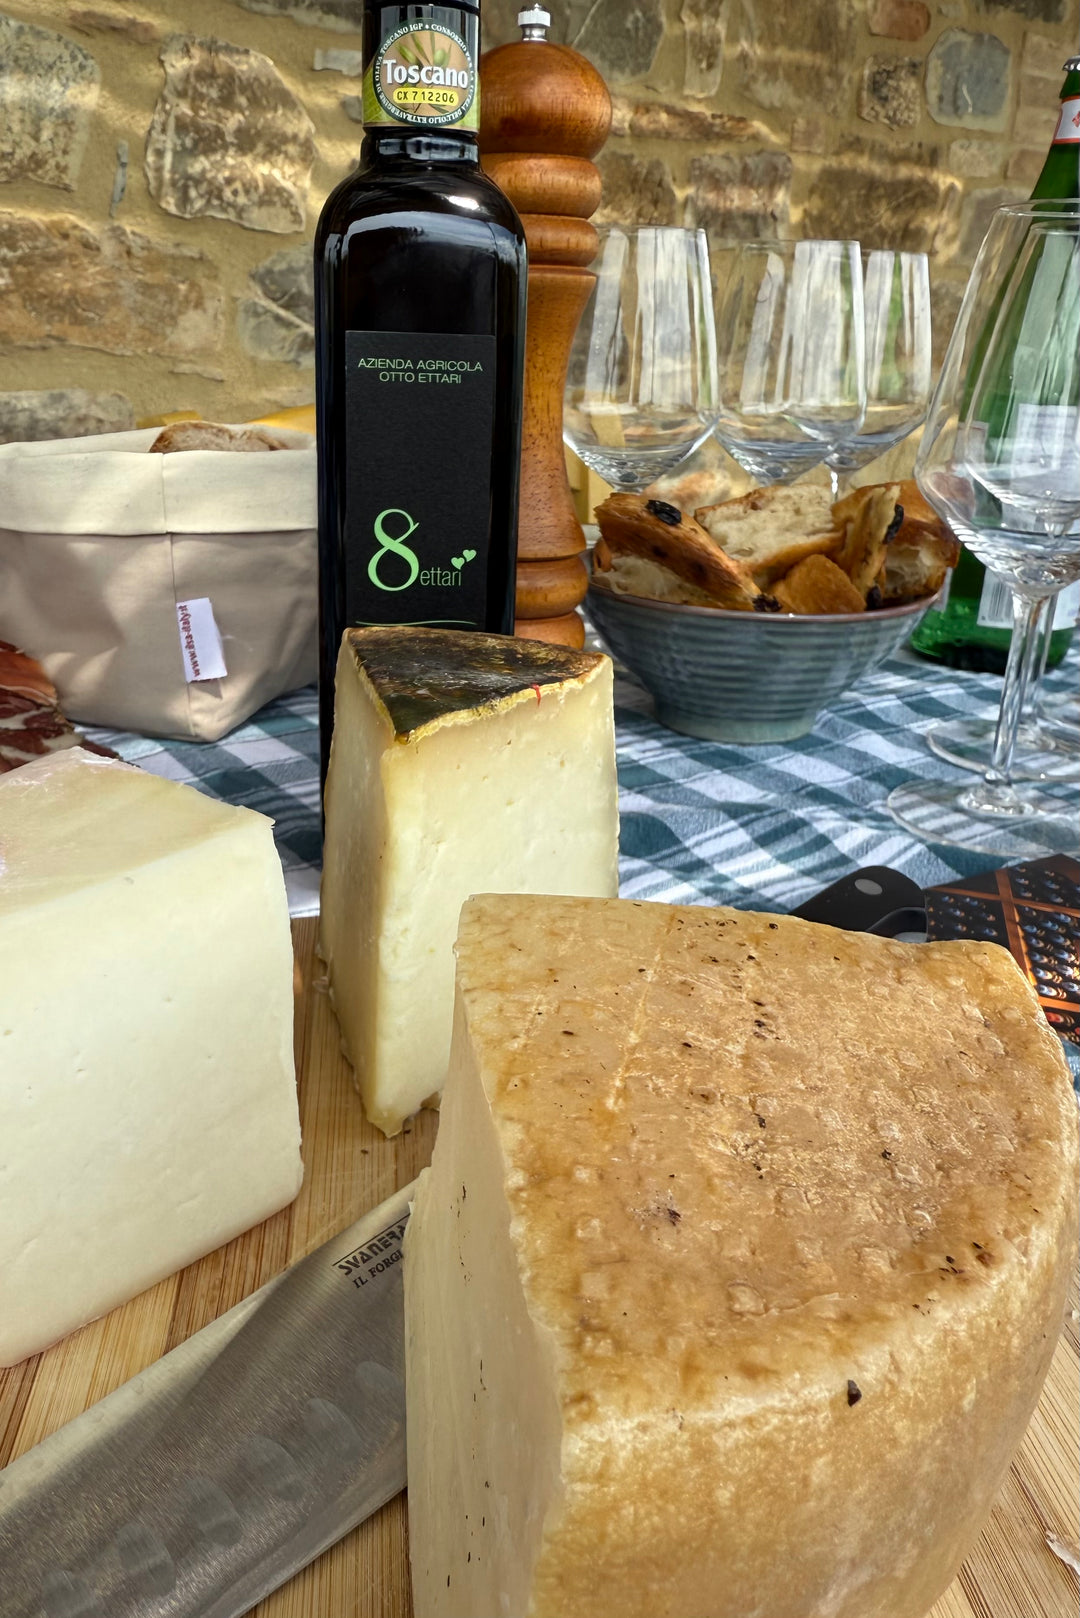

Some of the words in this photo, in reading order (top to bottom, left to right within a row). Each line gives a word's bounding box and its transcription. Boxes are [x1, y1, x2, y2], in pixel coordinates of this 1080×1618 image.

[409, 23, 424, 32] IGP
[380, 26, 409, 54] TOSCANO
[431, 23, 467, 52] CONSORZIO
[374, 56, 383, 81] OLIVA
[382, 59, 469, 89] Toscano
[358, 358, 414, 370] AZIENDA
[416, 360, 483, 372] AGRICOLA
[380, 371, 415, 383] OTTO
[418, 373, 462, 384] ETTARI
[352, 1276, 369, 1289] IL
